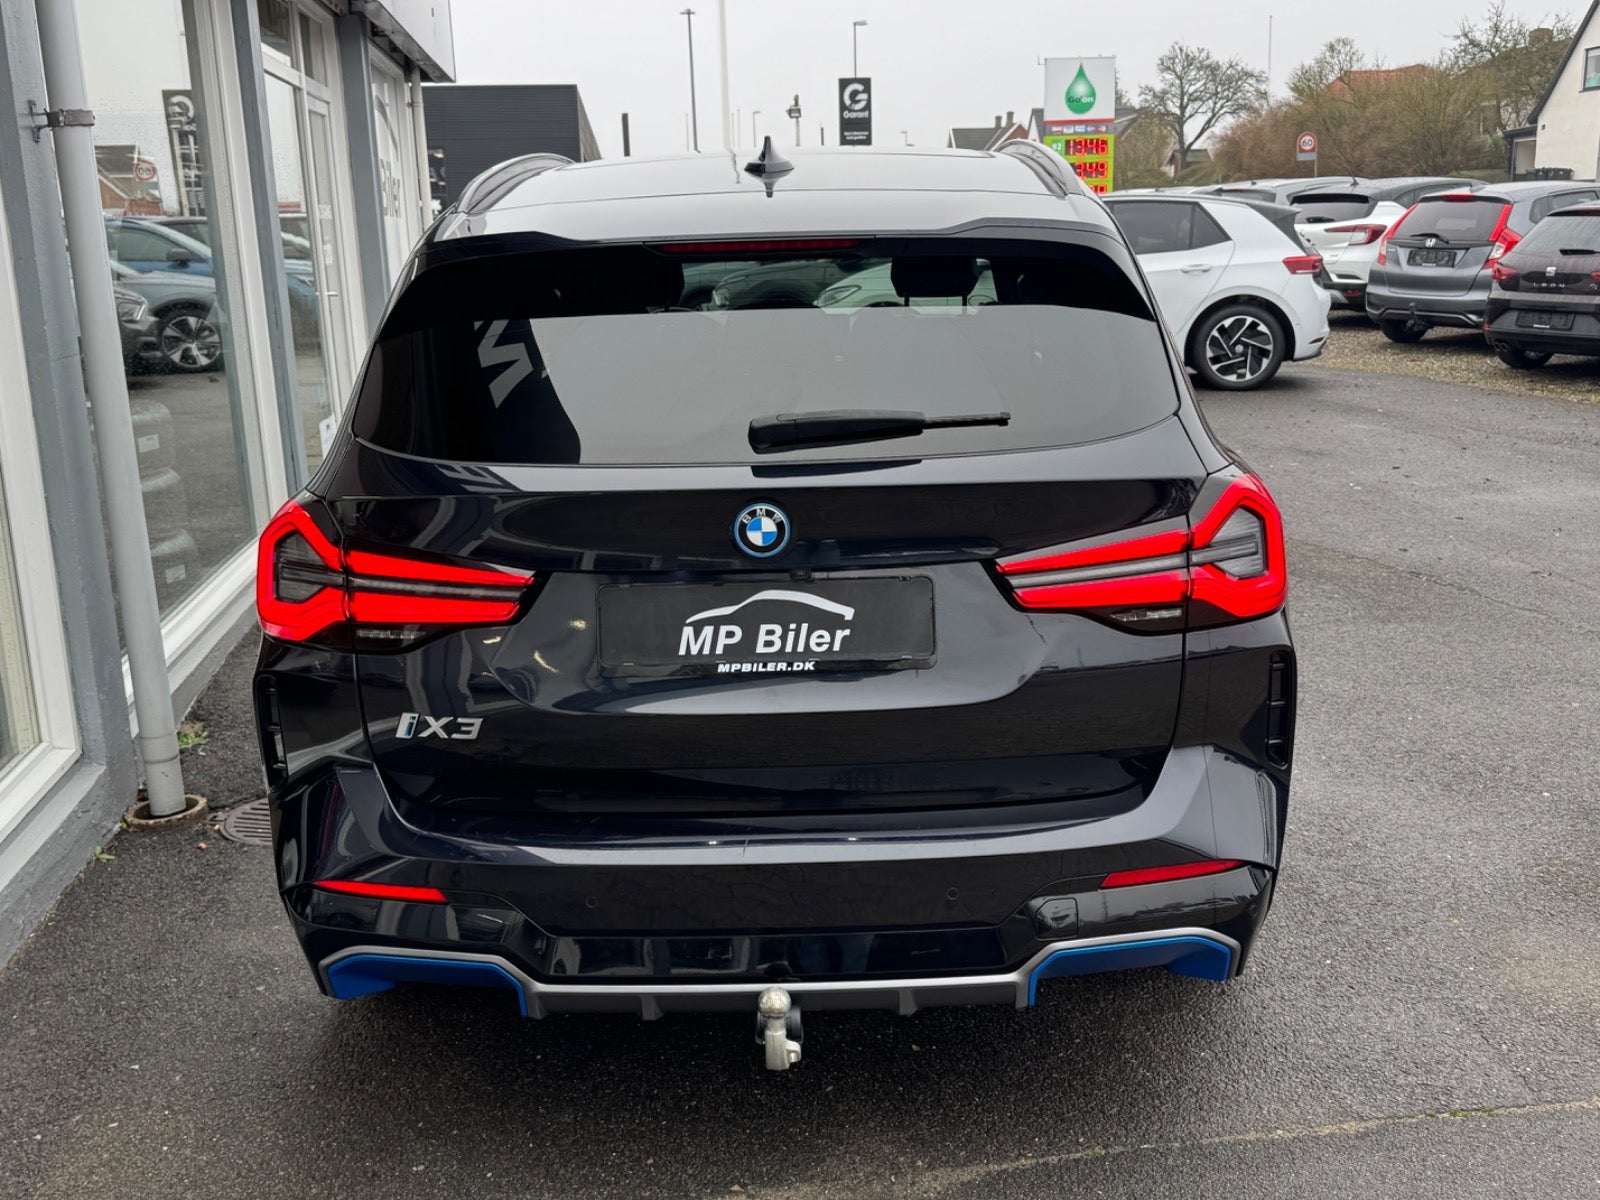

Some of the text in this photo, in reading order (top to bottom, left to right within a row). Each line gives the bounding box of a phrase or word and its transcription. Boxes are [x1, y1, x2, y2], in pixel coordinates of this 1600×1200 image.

[1302, 138, 1313, 147] 60
[741, 507, 782, 524] BMW
[678, 622, 851, 656] MP Biler
[717, 661, 816, 673] MPBILER.DK
